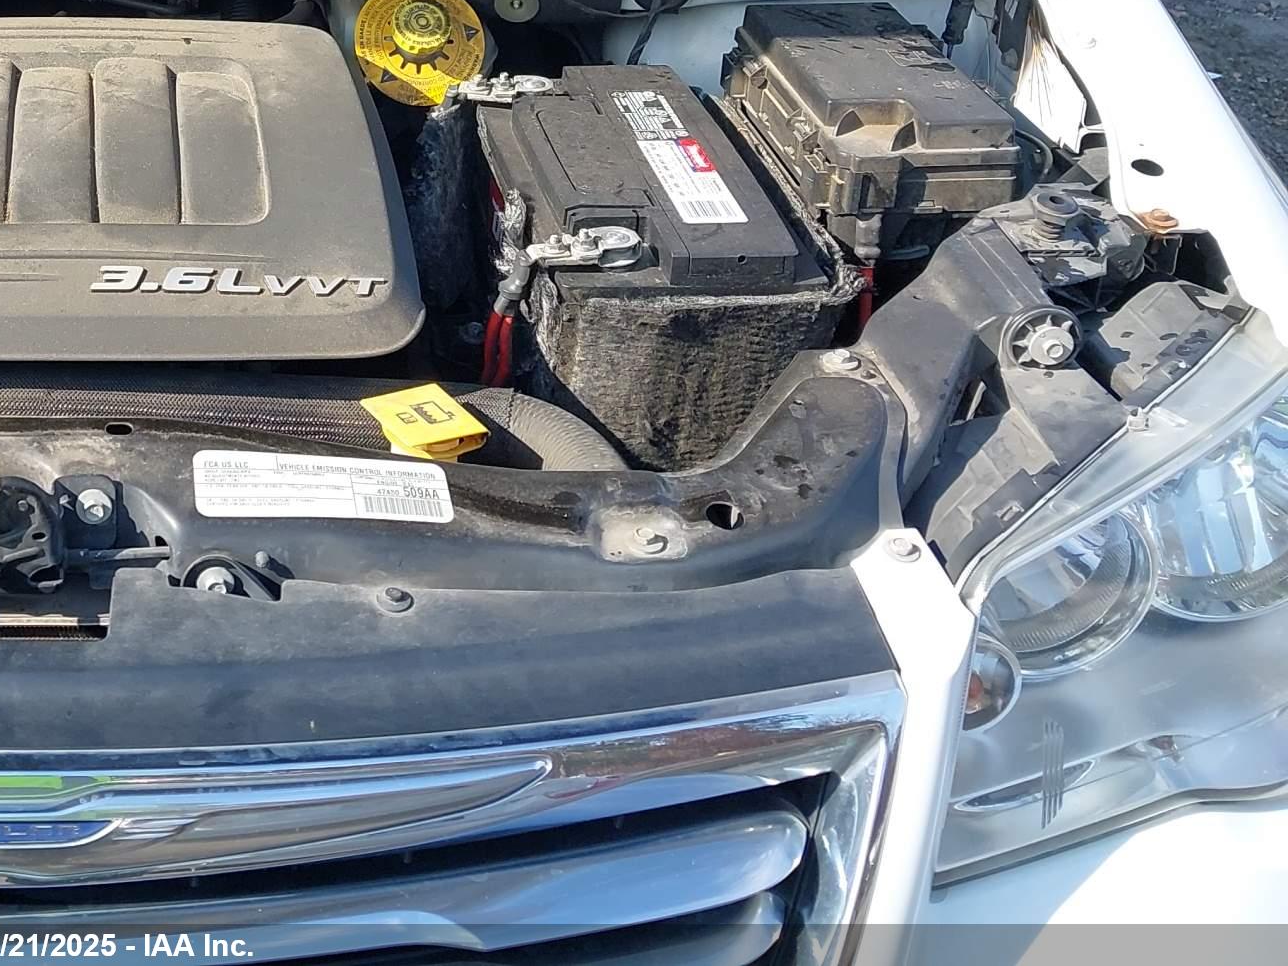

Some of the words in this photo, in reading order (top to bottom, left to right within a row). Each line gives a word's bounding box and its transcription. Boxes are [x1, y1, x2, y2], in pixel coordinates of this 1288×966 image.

[279, 463, 310, 472] VEHICLE
[312, 465, 347, 474] EMISSION
[349, 467, 382, 476] CONTROL
[385, 470, 436, 480] INFORMATION
[403, 486, 440, 500] 509AA
